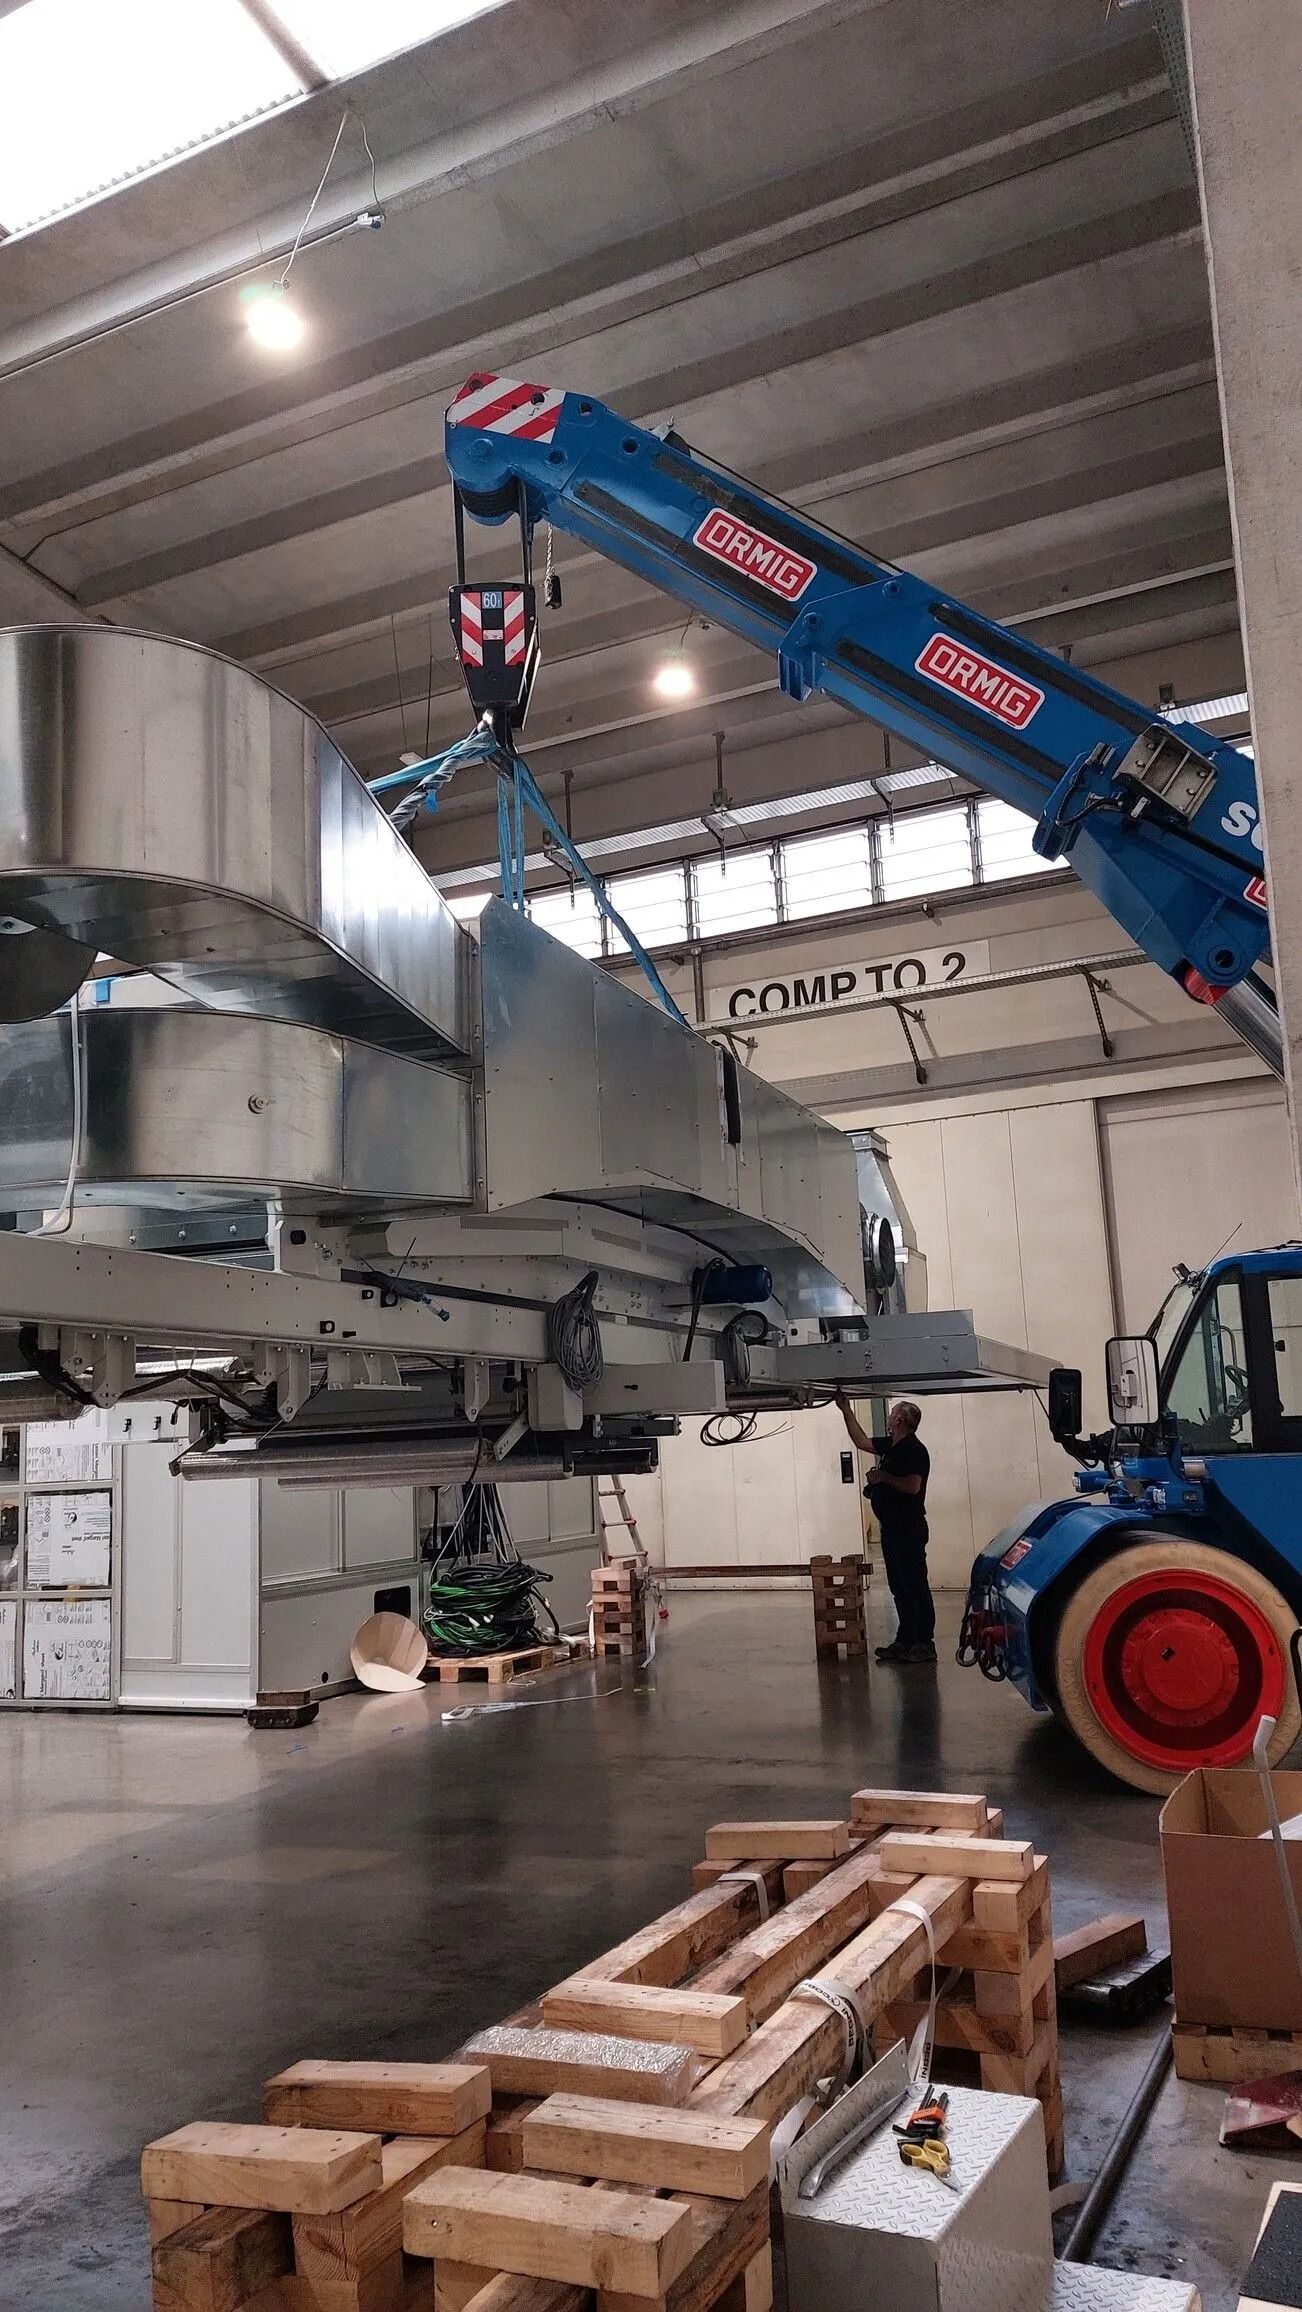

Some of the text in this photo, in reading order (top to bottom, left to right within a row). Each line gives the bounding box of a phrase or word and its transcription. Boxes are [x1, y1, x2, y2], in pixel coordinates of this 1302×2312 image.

[706, 519, 804, 590] ORMIG
[928, 644, 1032, 718] ORMIG
[942, 952, 966, 981] 2
